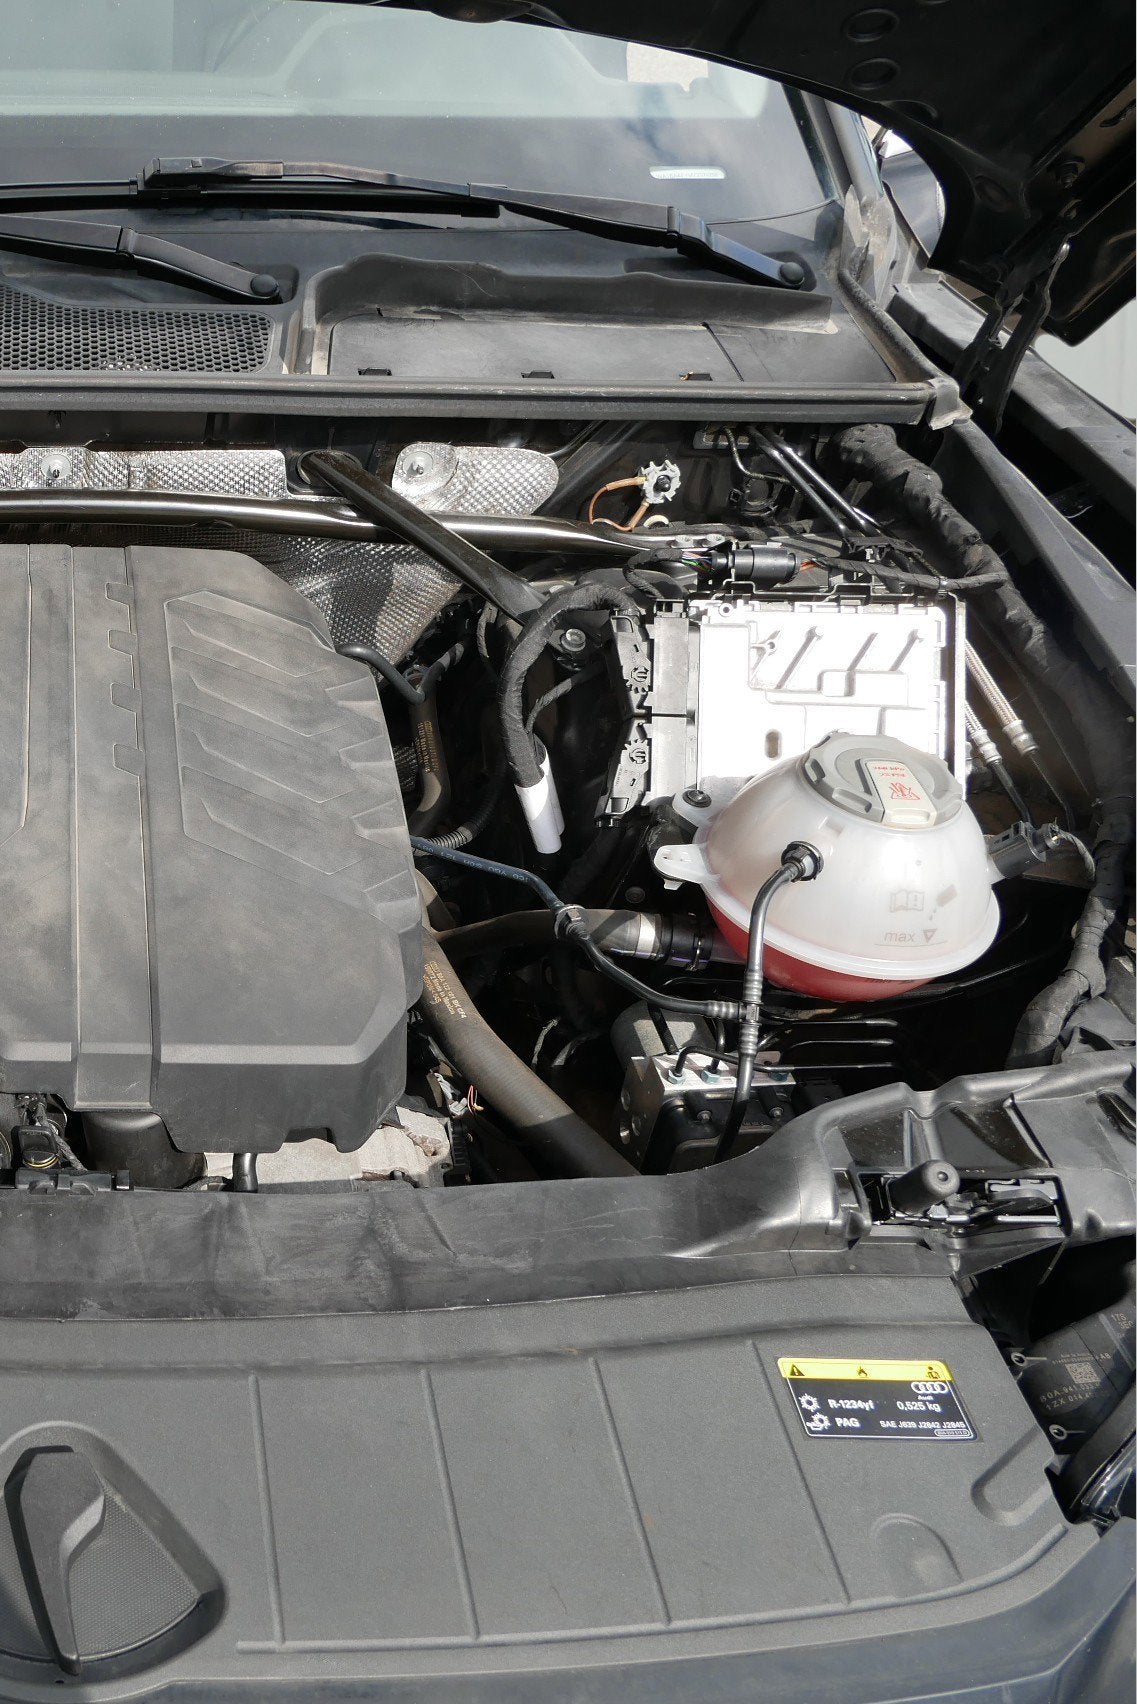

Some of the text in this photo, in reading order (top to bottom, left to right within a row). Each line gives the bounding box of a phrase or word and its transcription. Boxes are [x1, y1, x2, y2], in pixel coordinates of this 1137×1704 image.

[884, 931, 916, 942] max
[827, 1398, 942, 1413] R-1234yf 0,525 kg
[834, 1417, 860, 1428] PAG
[879, 1420, 897, 1428] SAE
[898, 1420, 917, 1429] J639
